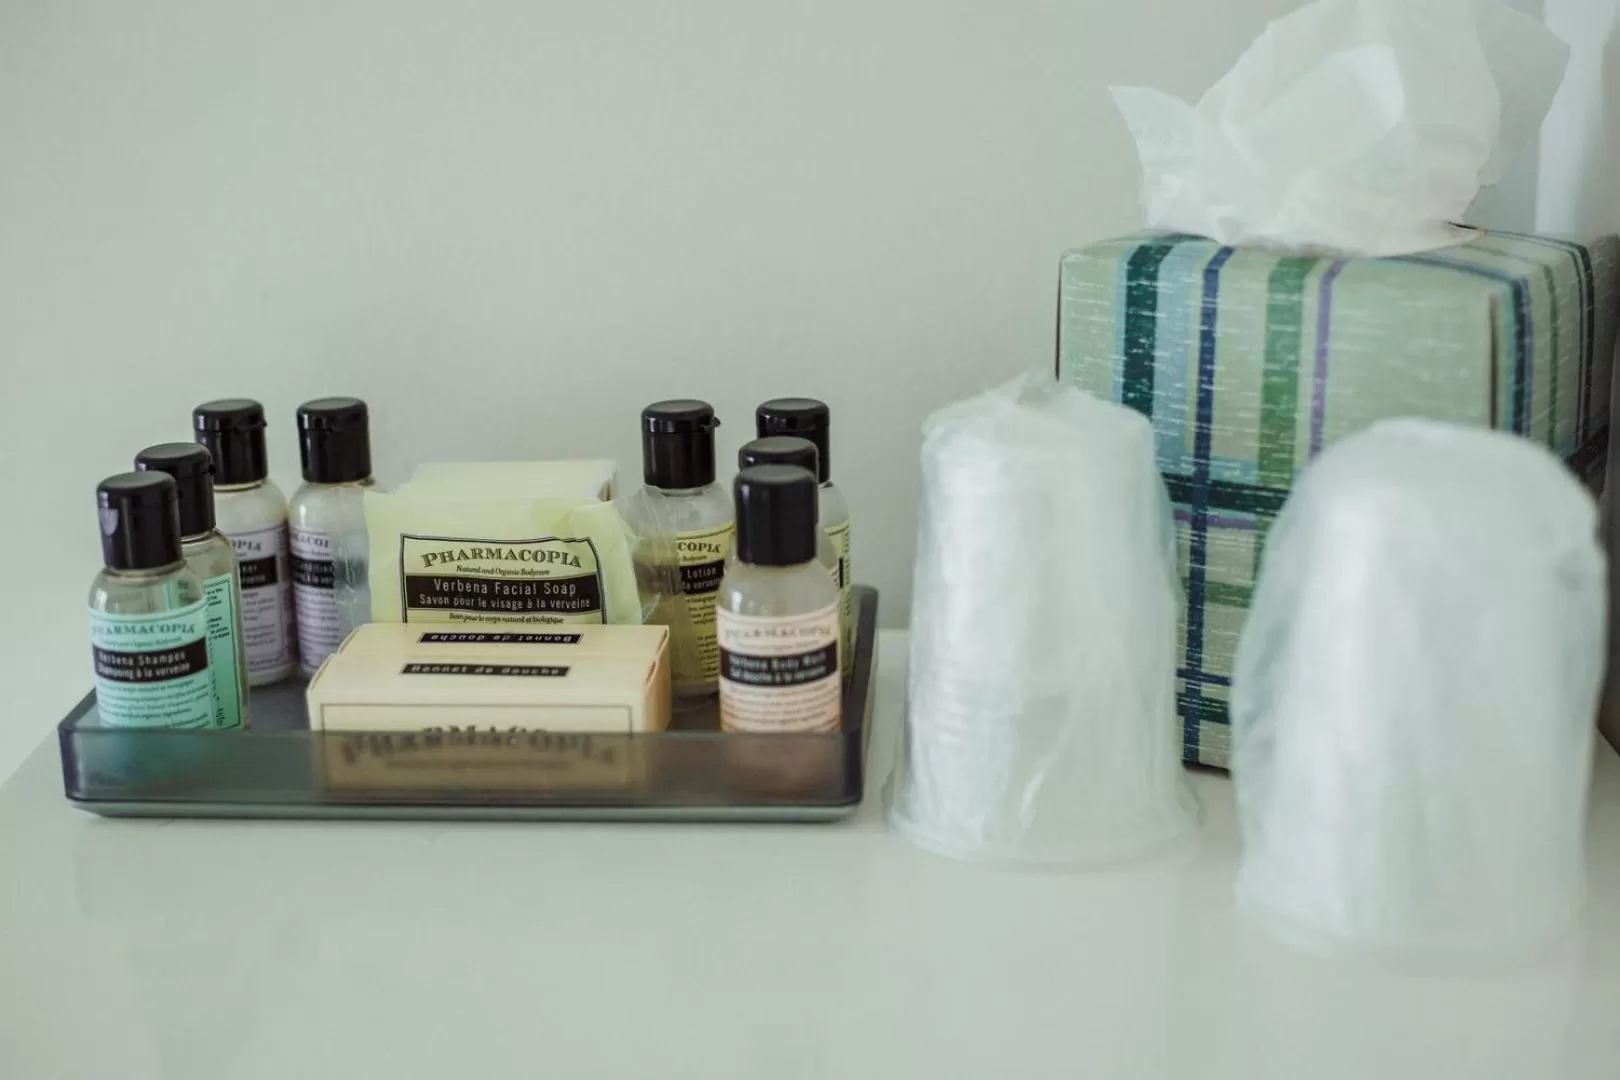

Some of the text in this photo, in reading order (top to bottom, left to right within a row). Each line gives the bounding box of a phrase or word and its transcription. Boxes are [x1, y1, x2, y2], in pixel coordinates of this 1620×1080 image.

[421, 547, 582, 569] PHARMACOPIA
[433, 578, 577, 598] Verbena Facial Soap
[419, 593, 450, 606] Savon
[453, 597, 475, 608] pour
[478, 598, 487, 608] le
[490, 598, 523, 611] visage
[536, 598, 546, 608] la
[550, 598, 592, 609] verveine
[430, 633, 486, 643] douche
[493, 633, 512, 643] de
[138, 650, 186, 667] Shampoo
[501, 667, 560, 676] douche
